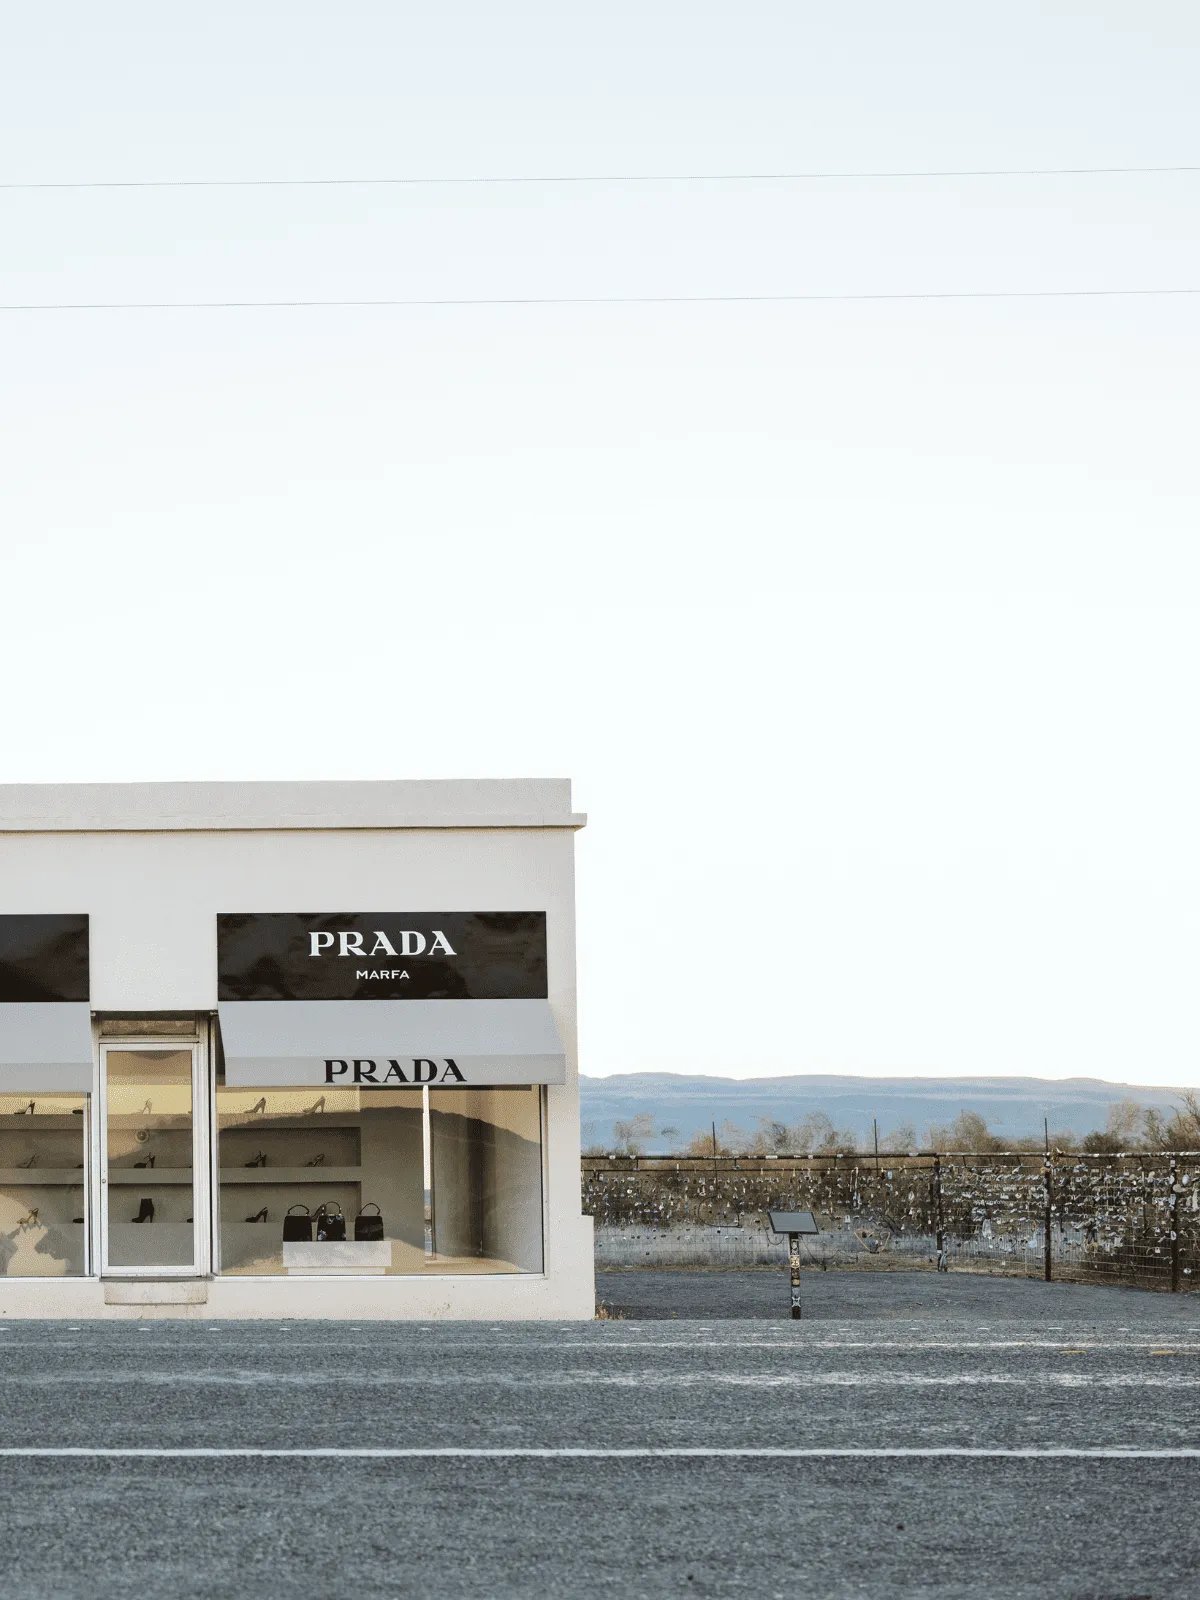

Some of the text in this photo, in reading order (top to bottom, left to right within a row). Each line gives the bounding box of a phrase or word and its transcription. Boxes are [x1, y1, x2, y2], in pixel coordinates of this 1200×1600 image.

[309, 931, 457, 957] PRADA
[356, 969, 410, 980] MARFA
[323, 1058, 468, 1084] PRADA
